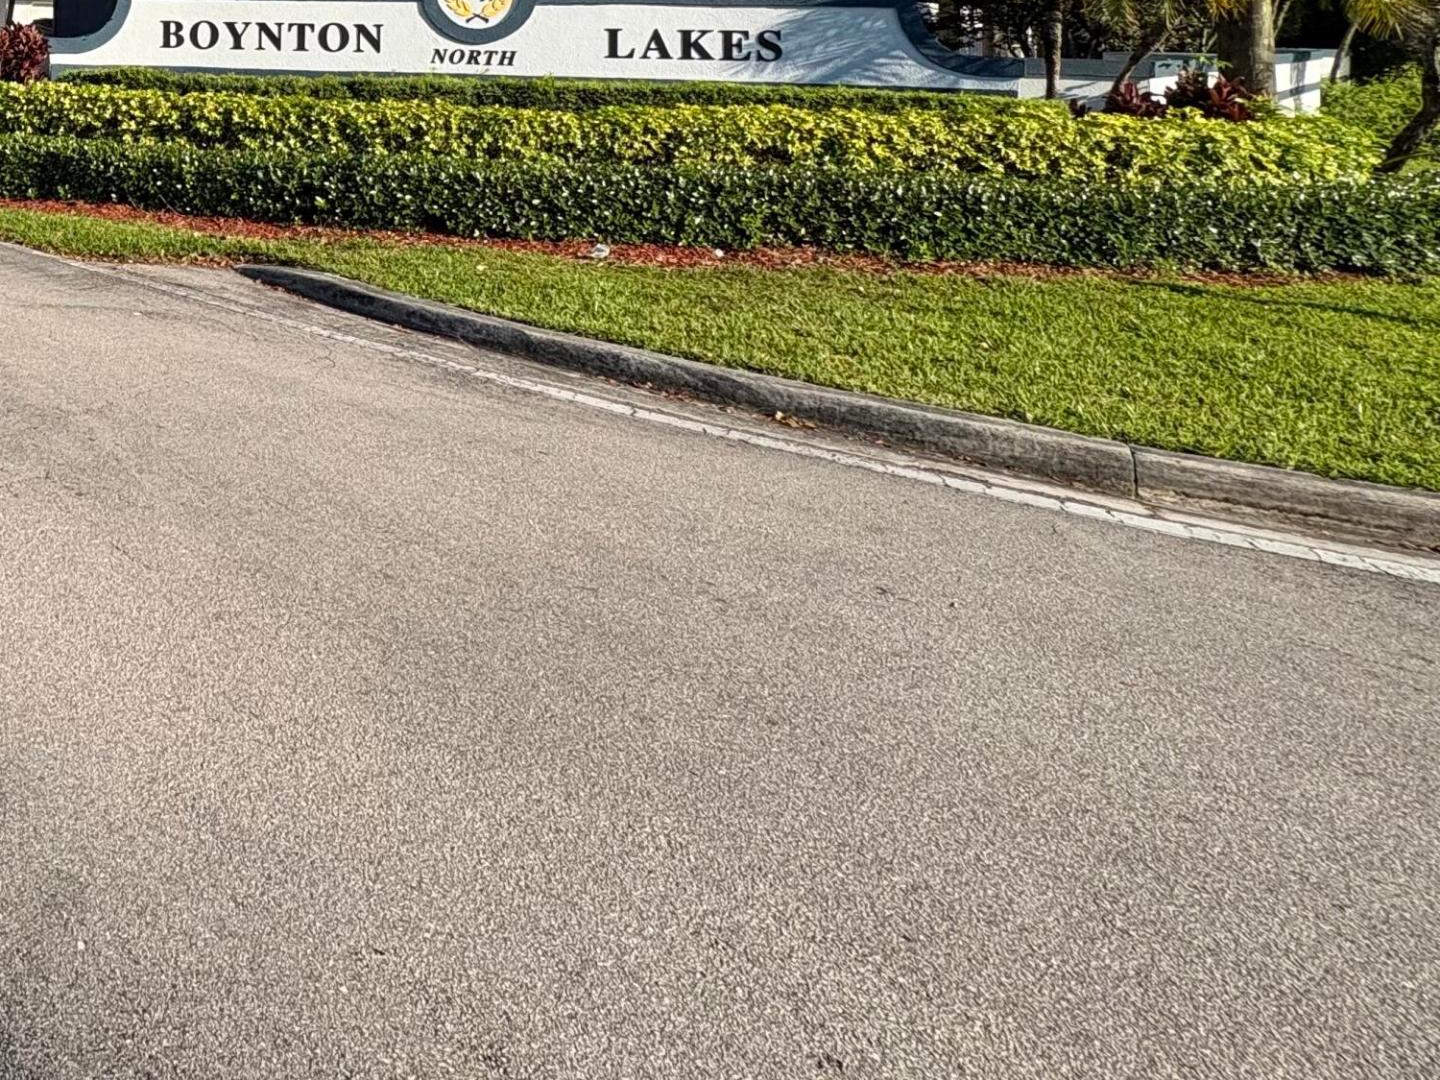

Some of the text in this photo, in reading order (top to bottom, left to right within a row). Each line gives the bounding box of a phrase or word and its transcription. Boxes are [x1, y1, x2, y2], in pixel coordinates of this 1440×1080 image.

[159, 20, 784, 62] BOYNTON LAKES
[430, 48, 517, 66] NORTH
